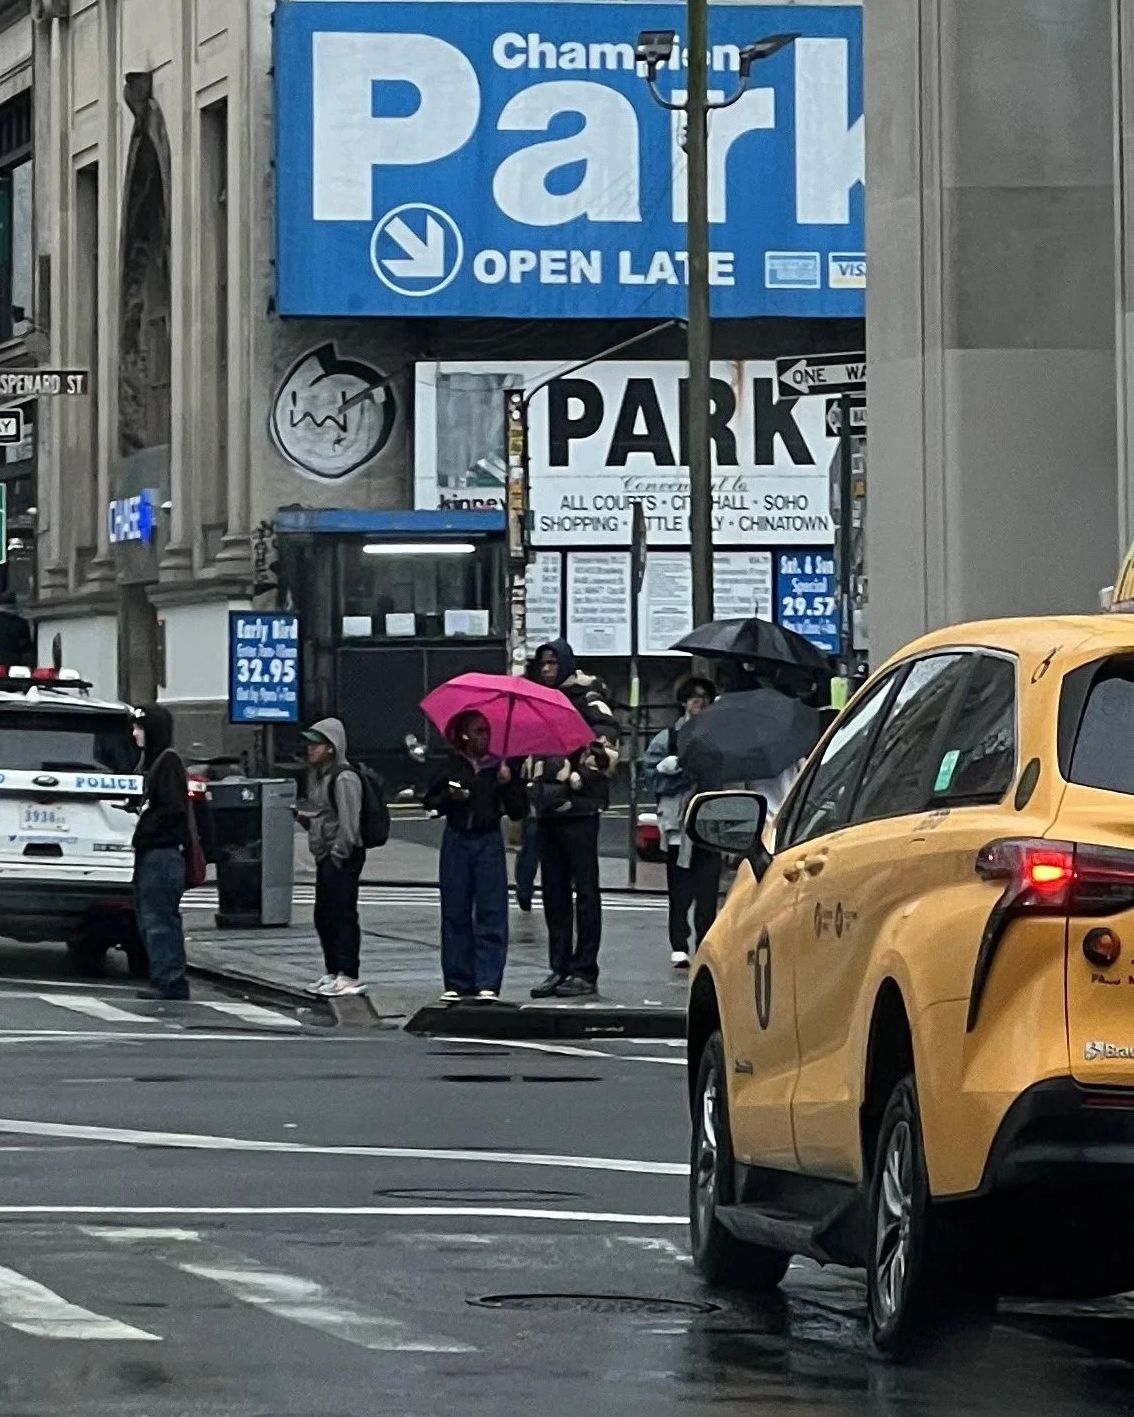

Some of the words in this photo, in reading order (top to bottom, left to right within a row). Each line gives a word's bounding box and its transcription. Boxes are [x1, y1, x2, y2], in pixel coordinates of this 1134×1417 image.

[473, 249, 602, 285] OPEN
[67, 375, 83, 394] ST
[793, 368, 827, 385] ONE
[548, 378, 816, 467] PARK
[560, 495, 588, 511] ALL
[763, 494, 809, 511] SOHO
[540, 515, 618, 532] SHOPPING
[739, 515, 829, 531] CHINATOWN
[782, 596, 836, 616] 29.57
[236, 658, 297, 683] 32.95
[75, 777, 138, 791] POLICE
